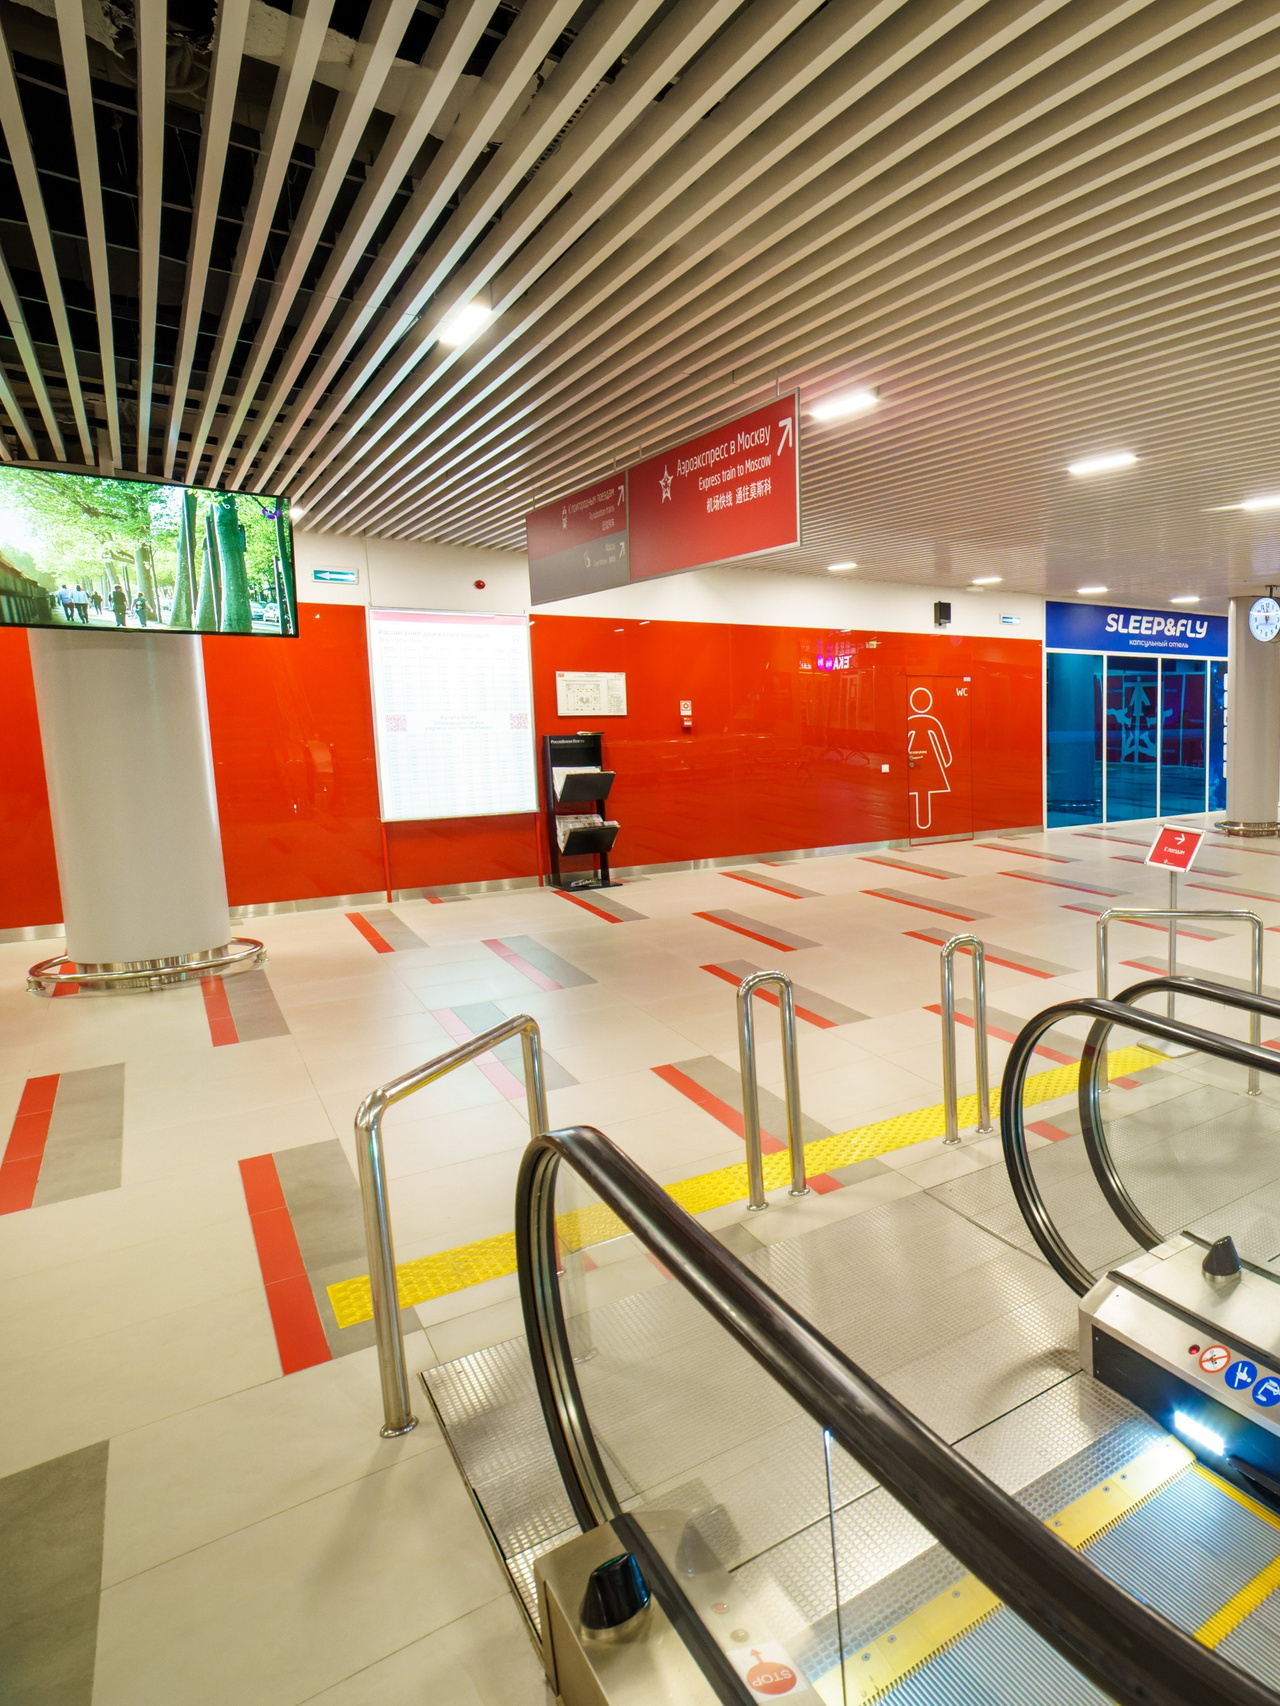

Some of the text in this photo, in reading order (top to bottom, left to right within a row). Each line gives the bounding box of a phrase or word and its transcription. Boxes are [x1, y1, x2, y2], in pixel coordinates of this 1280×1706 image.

[676, 425, 771, 477] Аэроэкспресс в Москву
[698, 454, 772, 491] Express train to Moscow
[706, 477, 772, 513] 机场快线 通往莫斯科
[1105, 613, 1208, 638] SLEEP&FLY
[955, 687, 968, 697] WC
[752, 1669, 792, 1687] STOP
